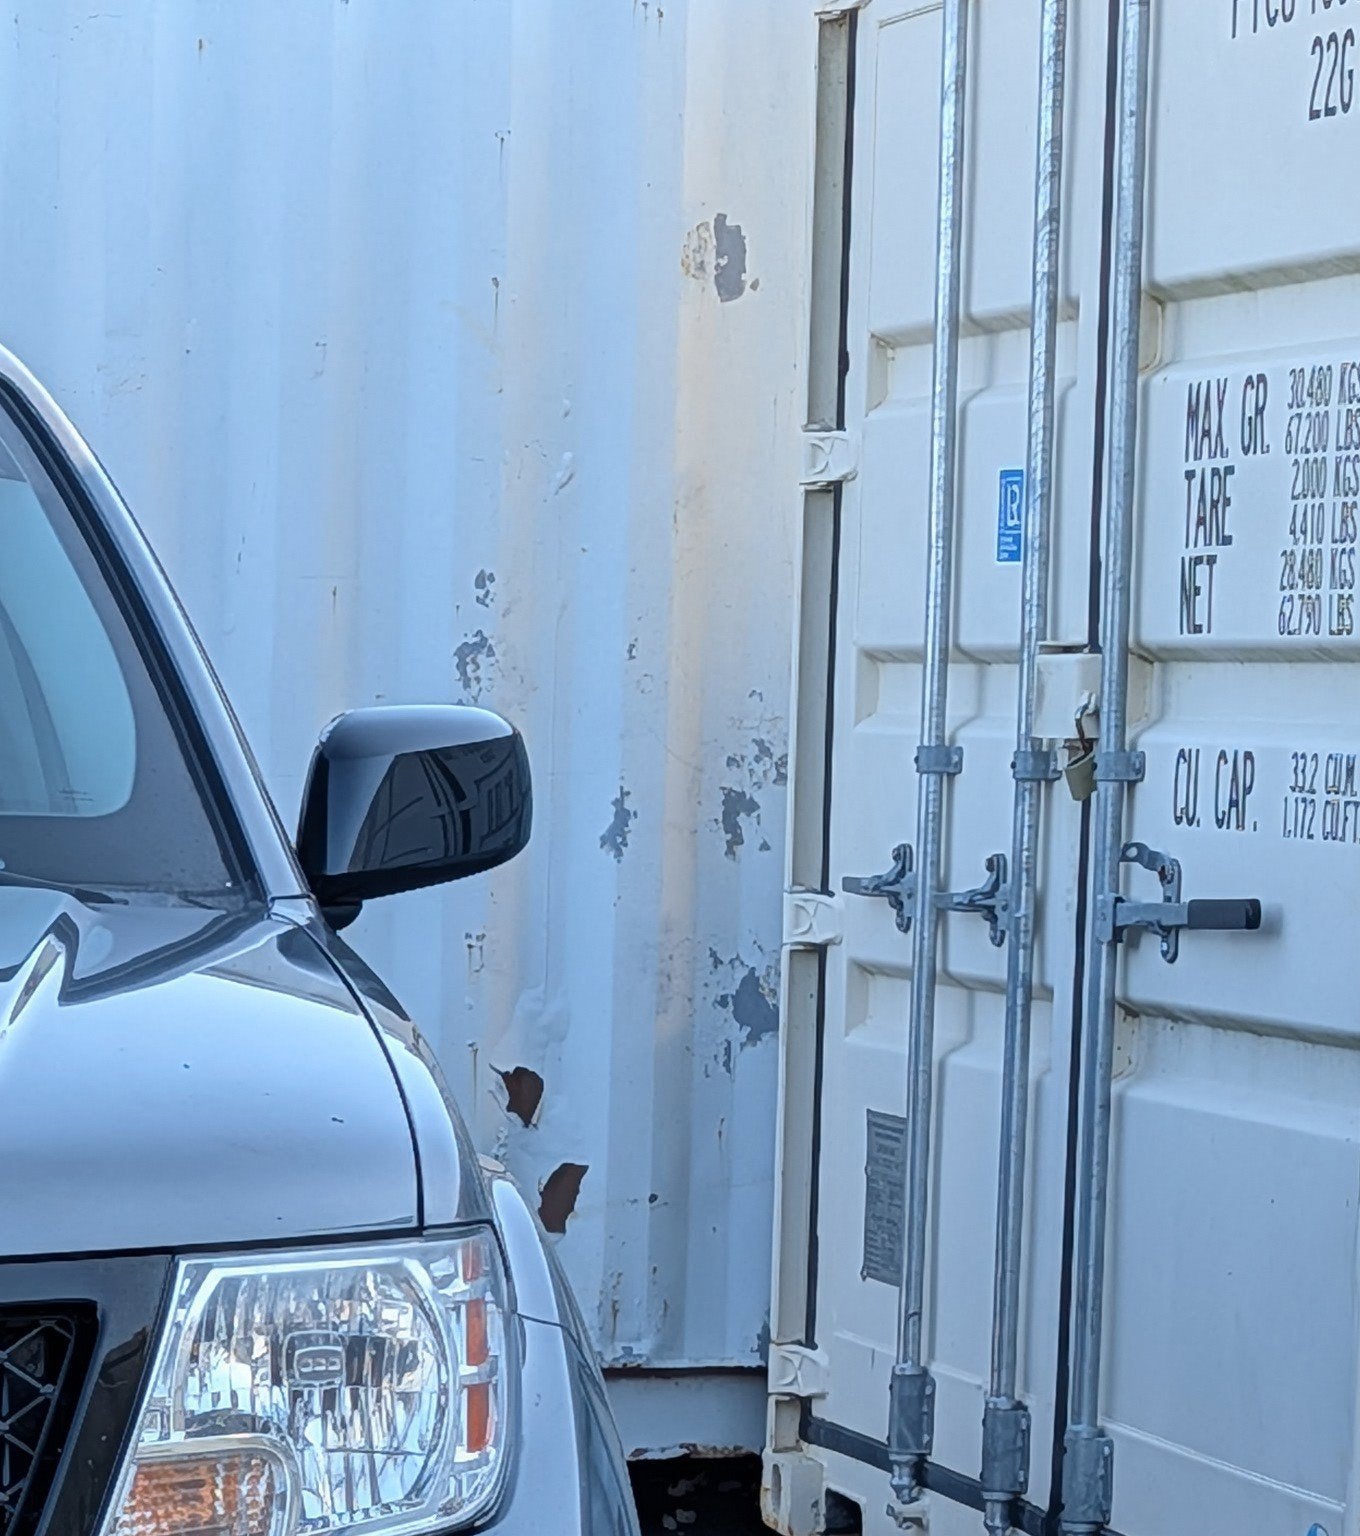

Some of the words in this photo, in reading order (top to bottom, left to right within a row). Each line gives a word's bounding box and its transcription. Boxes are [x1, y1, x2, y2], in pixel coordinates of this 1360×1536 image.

[1241, 373, 1270, 456] GR.
[1332, 454, 1360, 498] KGS
[1184, 465, 1235, 549] TARE
[1330, 500, 1358, 544] LBS
[1328, 546, 1356, 590] KGS
[1180, 554, 1217, 635] NET
[1328, 593, 1354, 636] LBS
